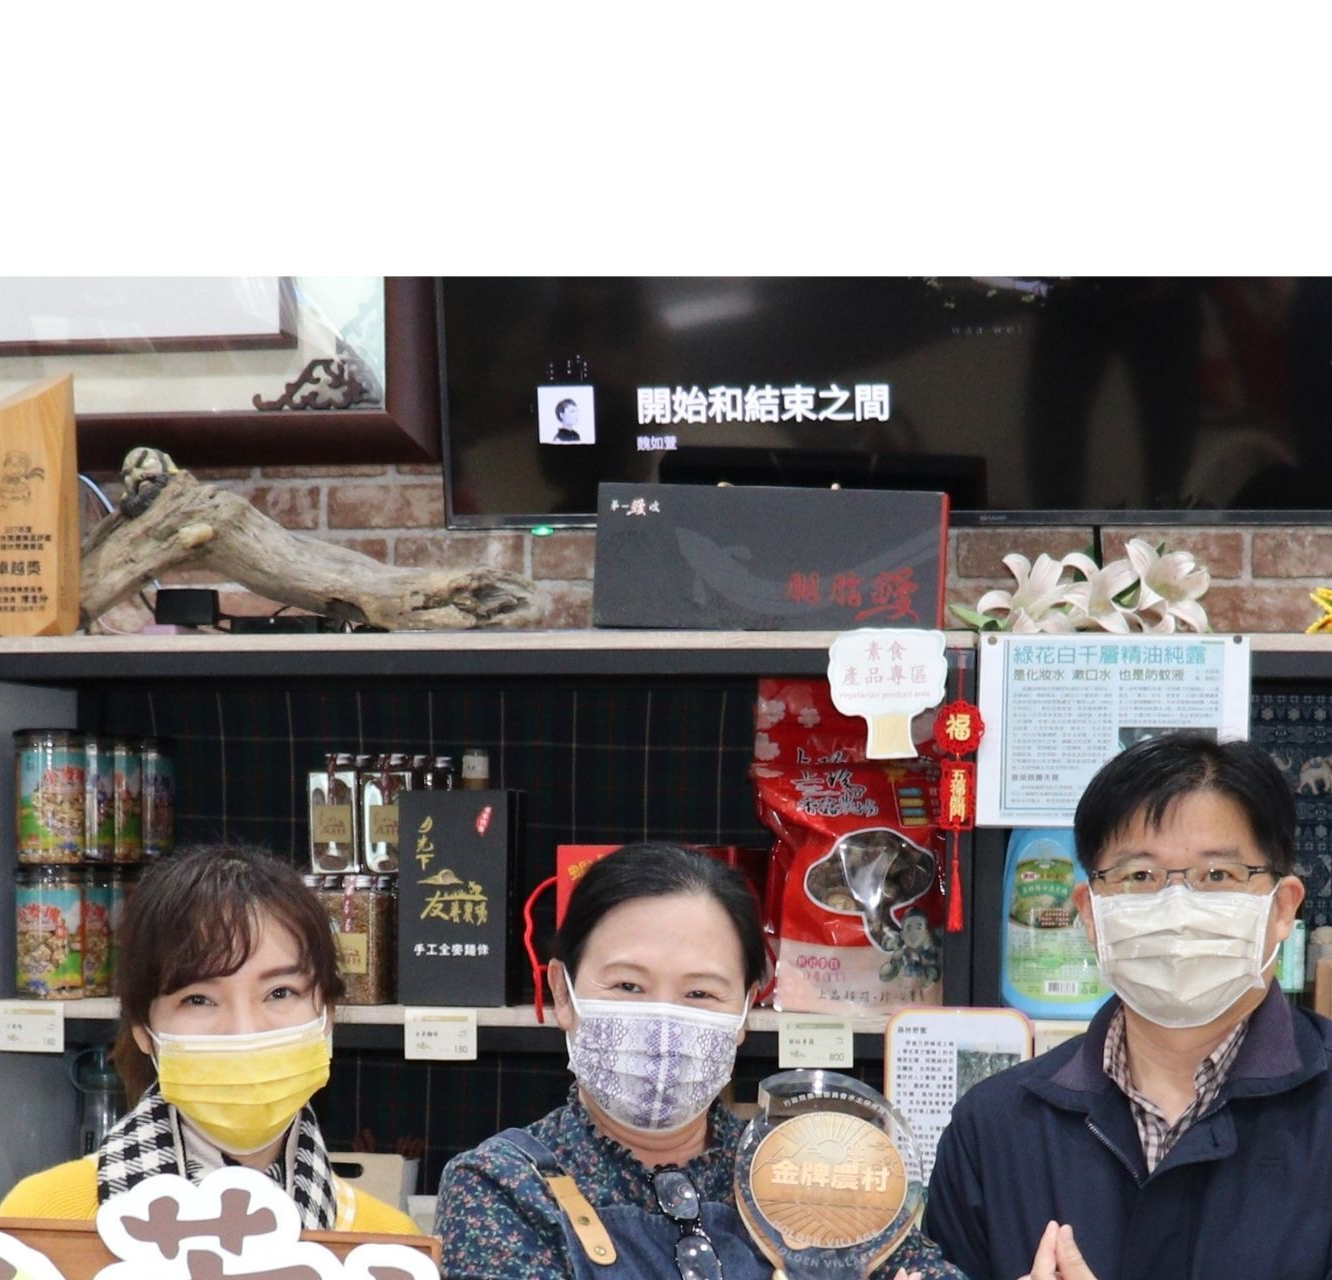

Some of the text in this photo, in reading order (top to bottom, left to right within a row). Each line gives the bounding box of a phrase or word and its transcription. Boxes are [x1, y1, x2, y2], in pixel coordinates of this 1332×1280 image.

[637, 384, 891, 425] 開始和結束之間
[636, 436, 678, 451] 魏如萱
[864, 640, 907, 662] 素食
[1013, 644, 1207, 666] 綠花白千層精油純露
[842, 664, 928, 686] 產品專區
[1013, 668, 1185, 682] 是化妝水 漱口水 也是防蚊液
[839, 690, 880, 700] Vegetarian
[881, 691, 913, 700] product
[945, 713, 971, 742] 福
[770, 1160, 891, 1192] 金牌農村
